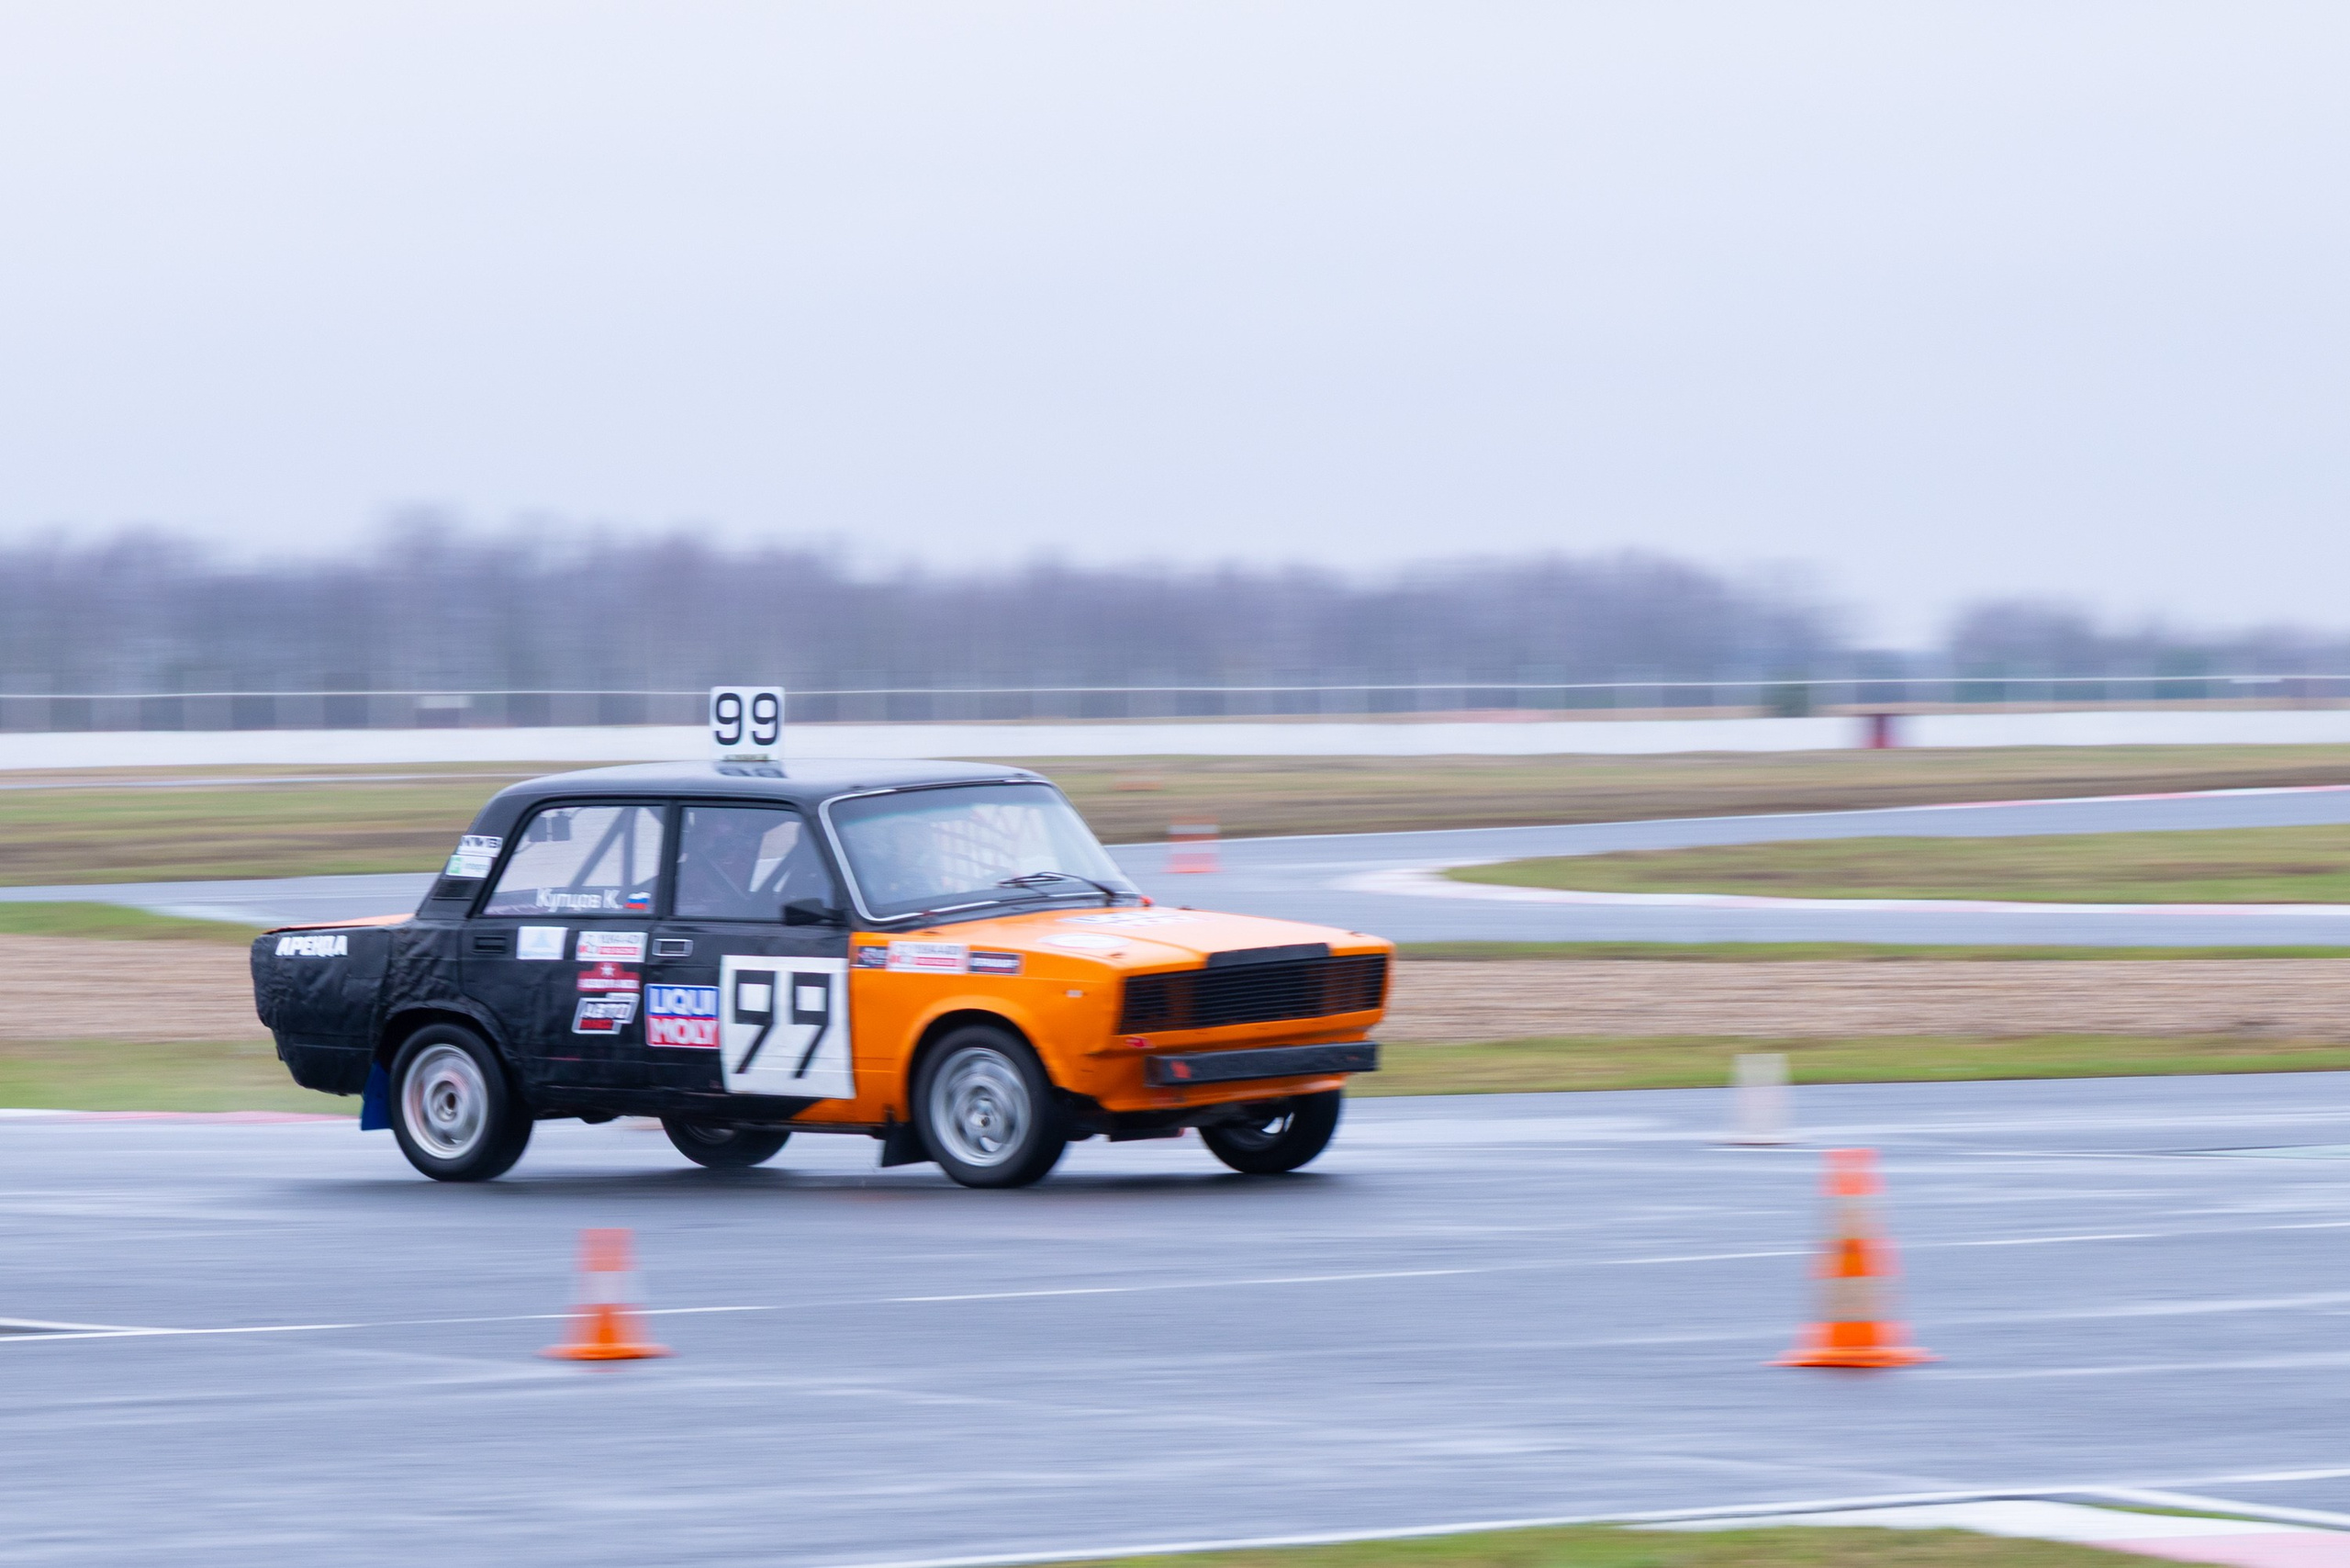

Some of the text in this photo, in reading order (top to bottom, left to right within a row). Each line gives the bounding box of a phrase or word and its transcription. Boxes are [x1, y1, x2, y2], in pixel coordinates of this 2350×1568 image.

[714, 692, 779, 746] 99
[274, 935, 349, 958] АРЕНДА
[648, 988, 718, 1015] LIQUI
[648, 1017, 720, 1045] MOLY
[733, 969, 831, 1080] 99
